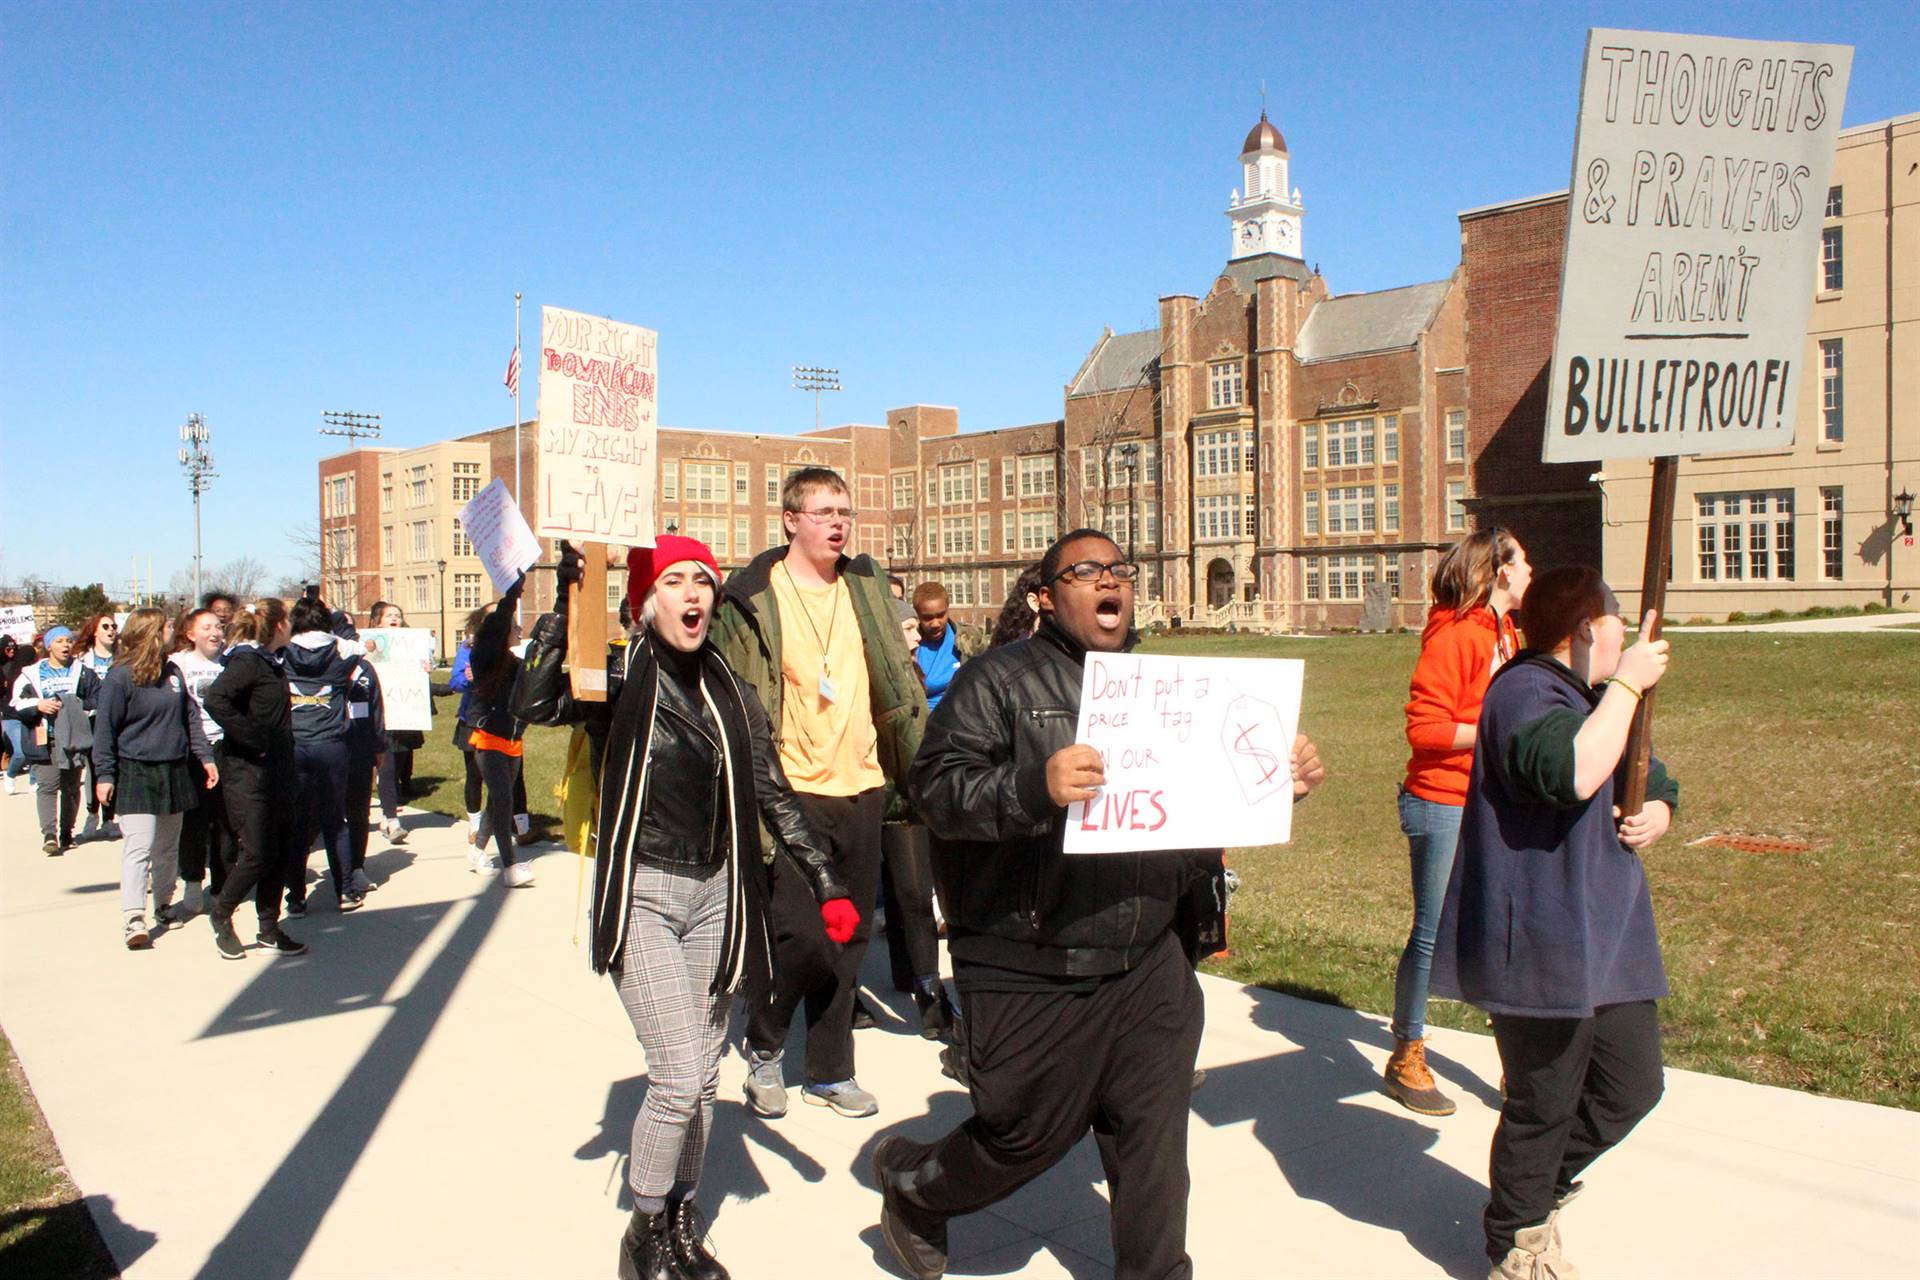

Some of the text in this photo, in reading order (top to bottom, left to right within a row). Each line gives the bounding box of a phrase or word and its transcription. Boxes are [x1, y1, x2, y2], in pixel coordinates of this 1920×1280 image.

[1601, 46, 1833, 132] THOUGHTS
[1583, 150, 1810, 232] & PRAYERS
[544, 311, 655, 369] YOUR RIGHT
[562, 352, 610, 390] OWN
[573, 383, 639, 432] ENDS
[1564, 355, 1790, 436] BULLETPROOF!
[544, 427, 648, 466] MY RIGHT
[542, 474, 639, 538] LIVE
[1154, 663, 1185, 710] put
[1194, 677, 1210, 699] a
[1160, 700, 1192, 743] tag
[1121, 748, 1160, 769] OUR
[1081, 790, 1168, 832] LIVES
